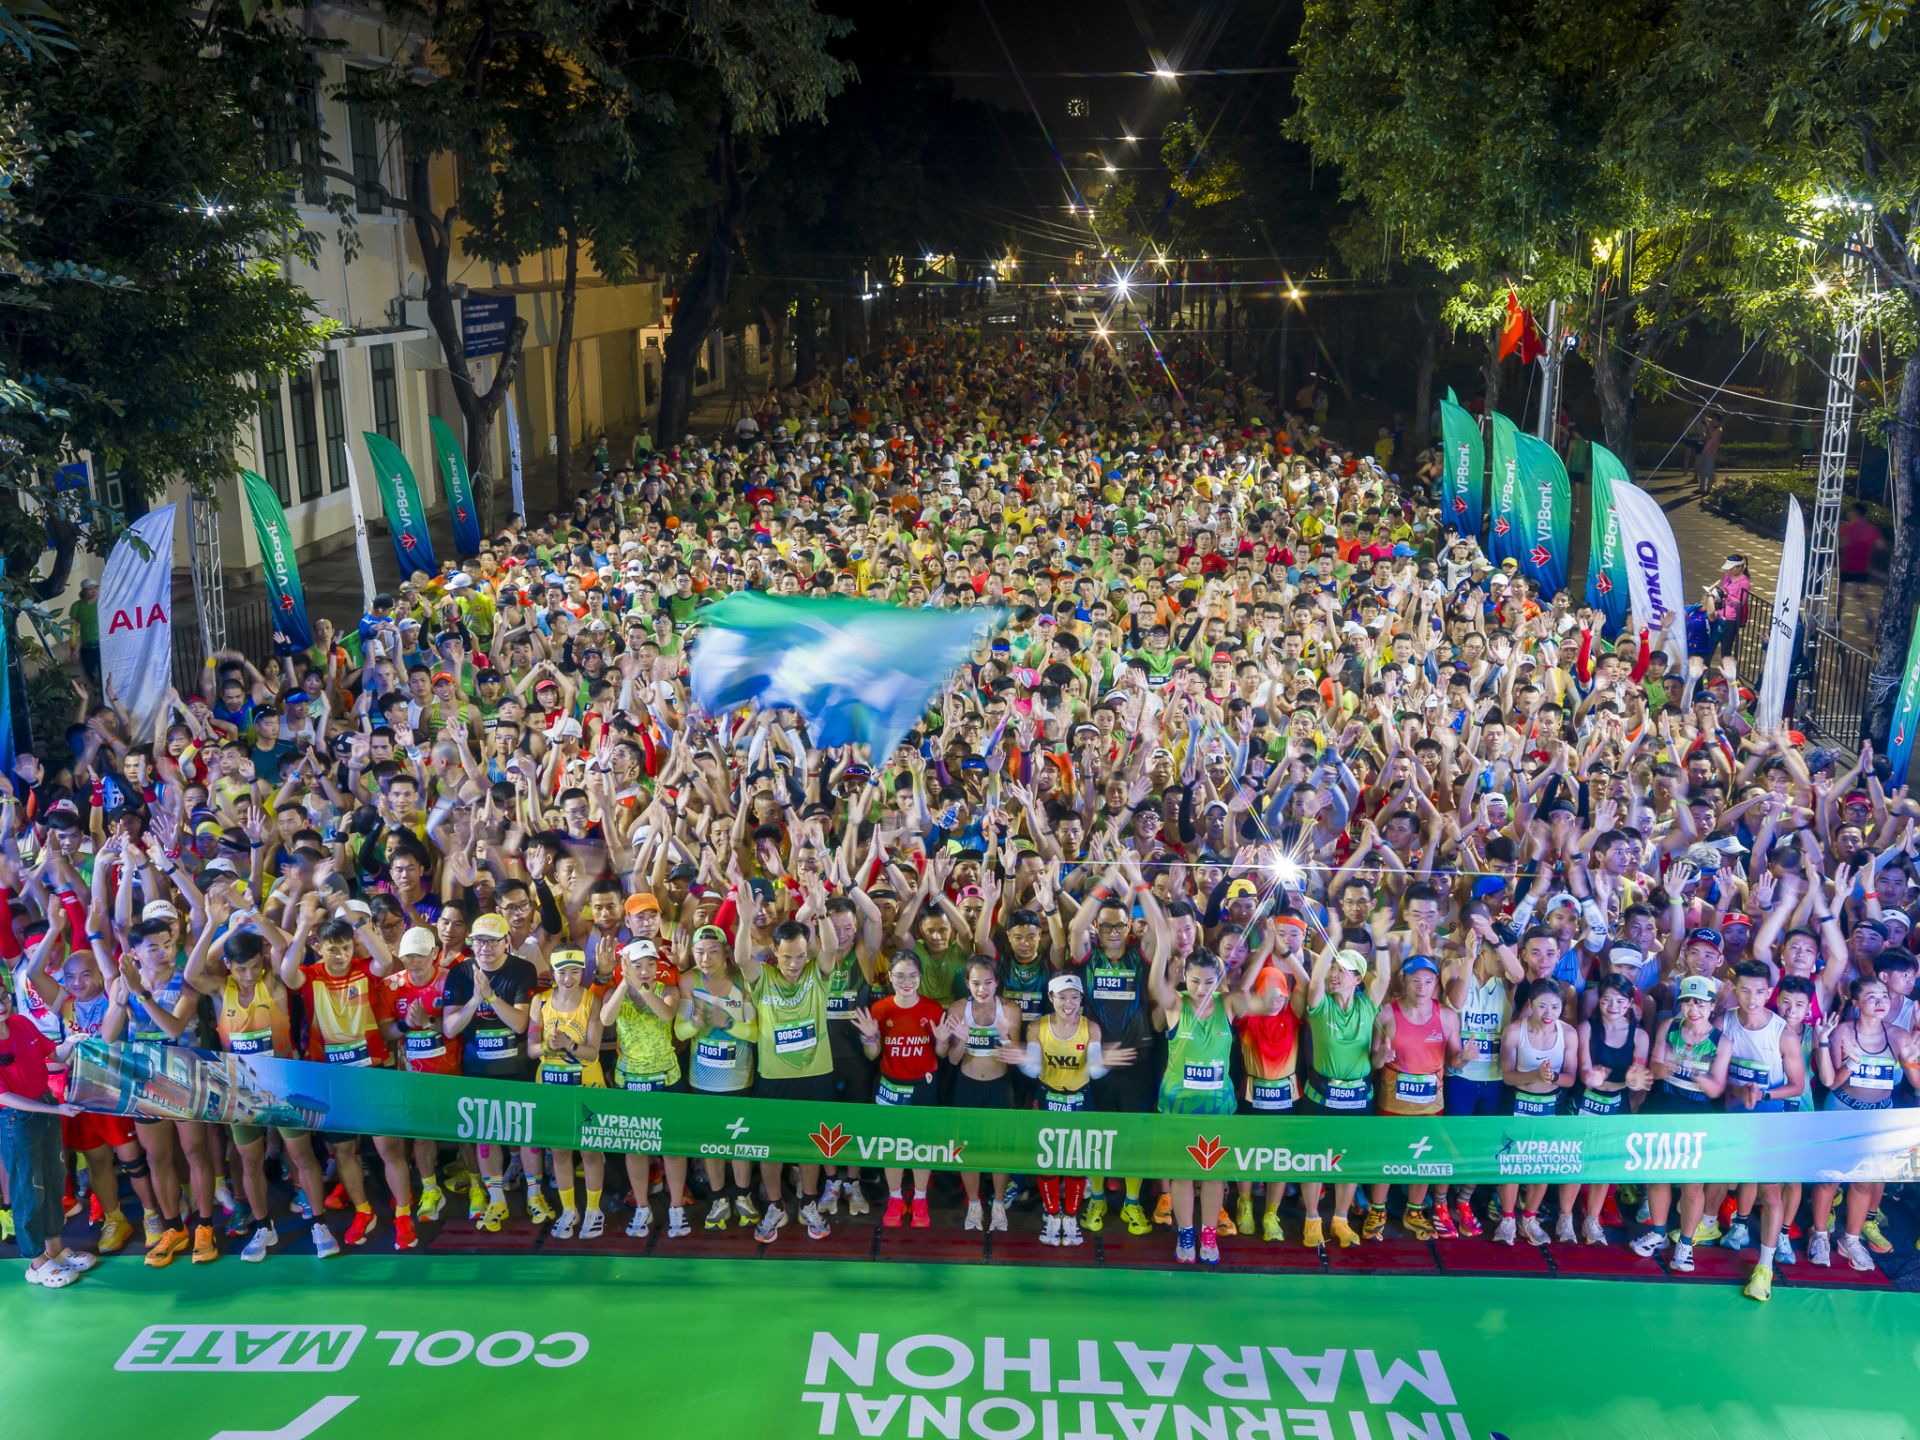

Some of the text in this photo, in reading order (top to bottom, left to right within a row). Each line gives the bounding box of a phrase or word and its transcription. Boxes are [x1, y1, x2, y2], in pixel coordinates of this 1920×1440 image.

[1457, 441, 1470, 494] VPBank
[1501, 456, 1517, 513] VPBank
[391, 473, 412, 527] VPBank
[1537, 480, 1554, 543] VPBank
[1602, 504, 1619, 569] VPBank
[266, 518, 289, 587] VPBank
[108, 603, 167, 634] AIA
[1903, 652, 1920, 712] VPB
[1096, 977, 1121, 988] 91321
[232, 1040, 258, 1051] 90534
[407, 1038, 432, 1048] 90763
[906, 1035, 930, 1045] NINH
[891, 1047, 923, 1057] RUN
[544, 1072, 569, 1083] 90118
[1186, 1066, 1212, 1078] 91410
[878, 1085, 898, 1101] 91098
[1255, 1087, 1281, 1098] 91060
[1330, 1087, 1355, 1098] 90504
[1399, 1082, 1425, 1093] 91417
[1048, 1102, 1072, 1112] 90746
[1518, 1102, 1543, 1113] 91568
[1584, 1098, 1610, 1113] 91219
[457, 1096, 537, 1143] START
[597, 1114, 663, 1131] VPBANK
[581, 1125, 662, 1140] INTERNATIONAL
[580, 1135, 662, 1152] MARATHON
[856, 1136, 965, 1164] VPBank
[1036, 1127, 1118, 1170] START
[1516, 1140, 1584, 1154] VPBANK
[1624, 1132, 1707, 1171] START
[1234, 1147, 1344, 1172] VPBank
[1499, 1153, 1582, 1164] INTERNATIONAL
[1499, 1163, 1583, 1176] MARATHON
[804, 1331, 1458, 1405] MARATHON
[801, 1391, 1474, 1440] INTERNATIONAL
